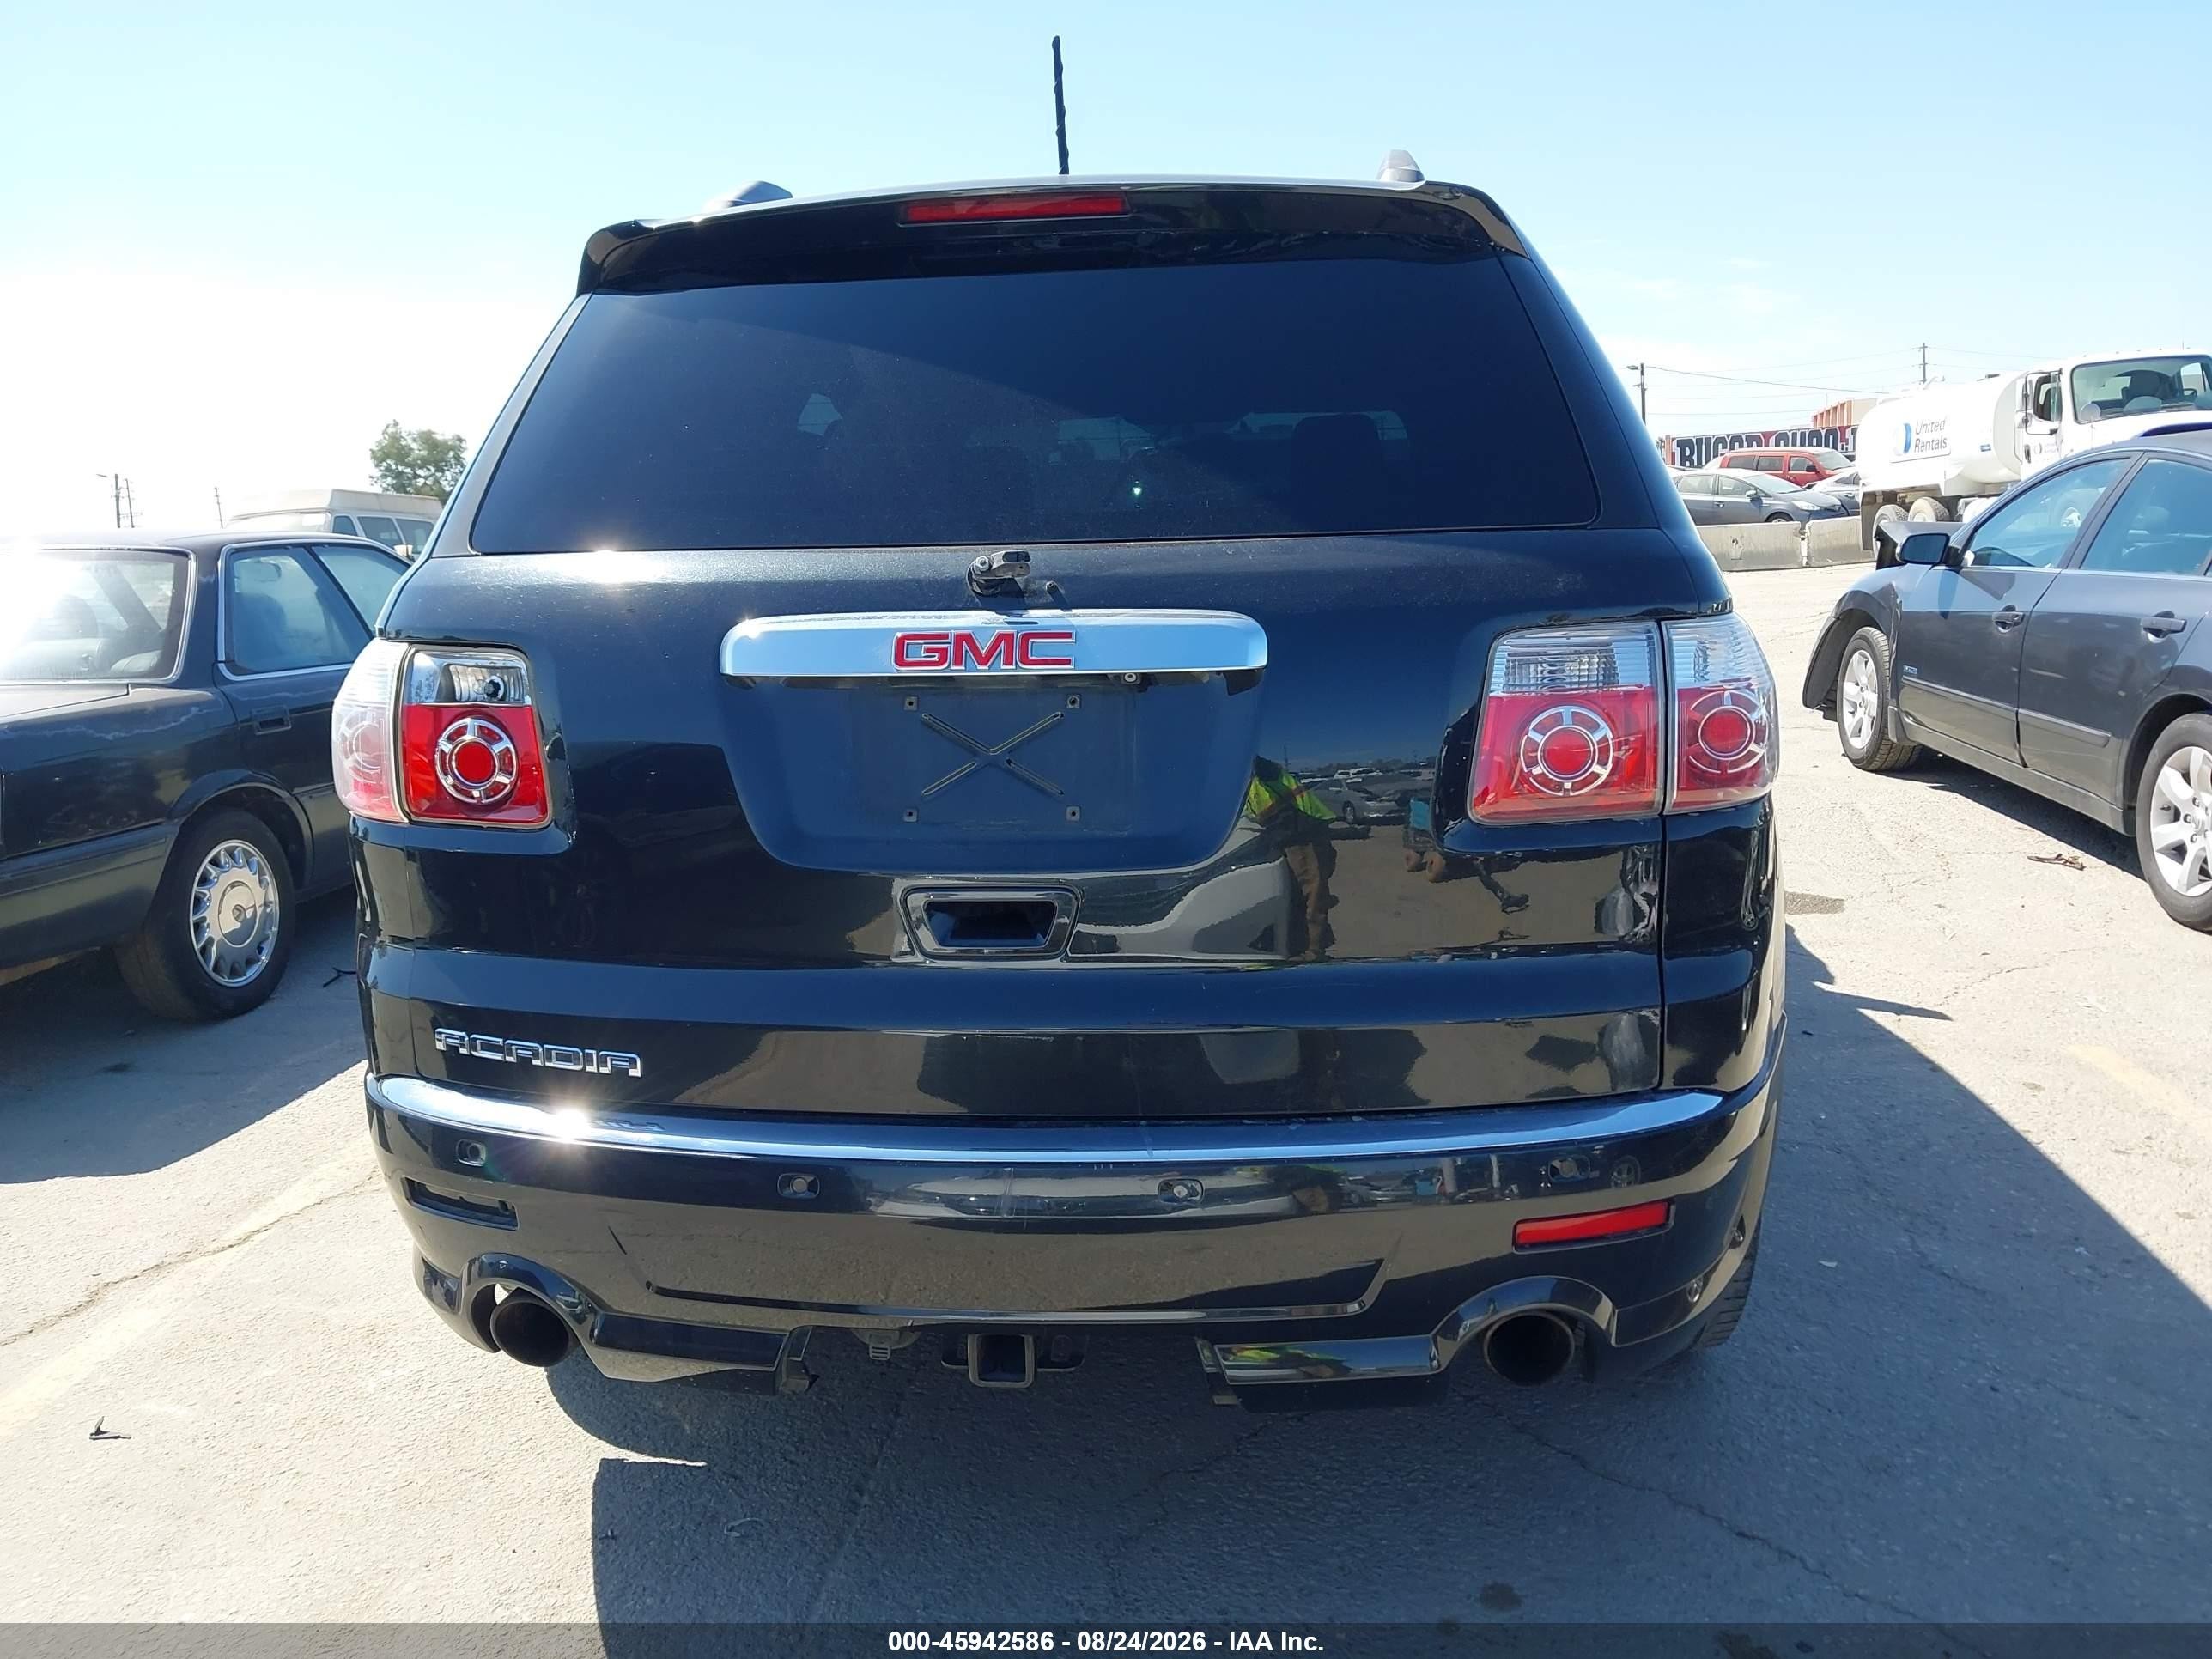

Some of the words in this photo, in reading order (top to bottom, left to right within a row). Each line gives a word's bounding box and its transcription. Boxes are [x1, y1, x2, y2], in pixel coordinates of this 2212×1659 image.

[1915, 416, 1947, 435] United
[1914, 434, 1948, 453] Rentals
[892, 629, 1075, 671] GMC
[435, 1028, 641, 1078] ACADIA
